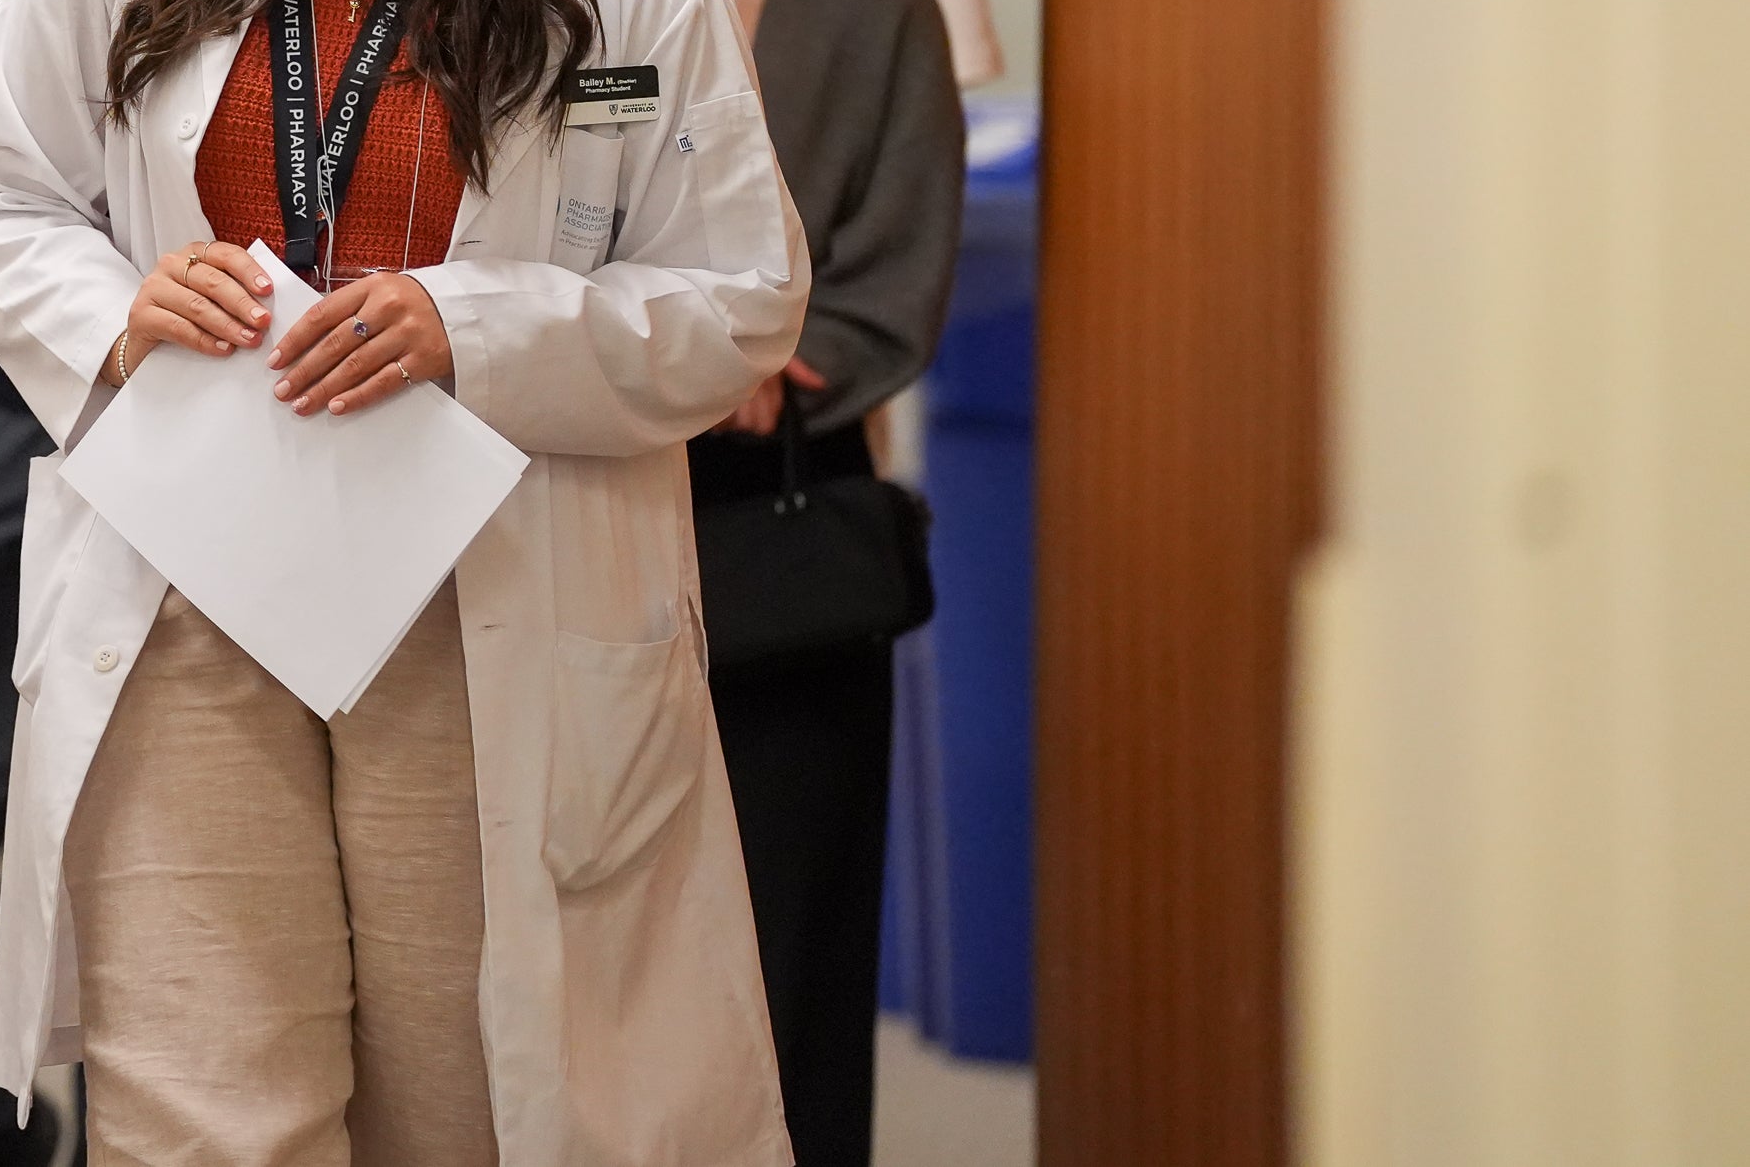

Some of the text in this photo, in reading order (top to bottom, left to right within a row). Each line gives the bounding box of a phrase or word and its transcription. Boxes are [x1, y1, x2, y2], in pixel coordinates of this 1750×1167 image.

[579, 78, 604, 87] Bailey
[605, 77, 616, 85] M.
[289, 109, 307, 218] PHARMACY
[568, 198, 606, 214] ONTARIO
